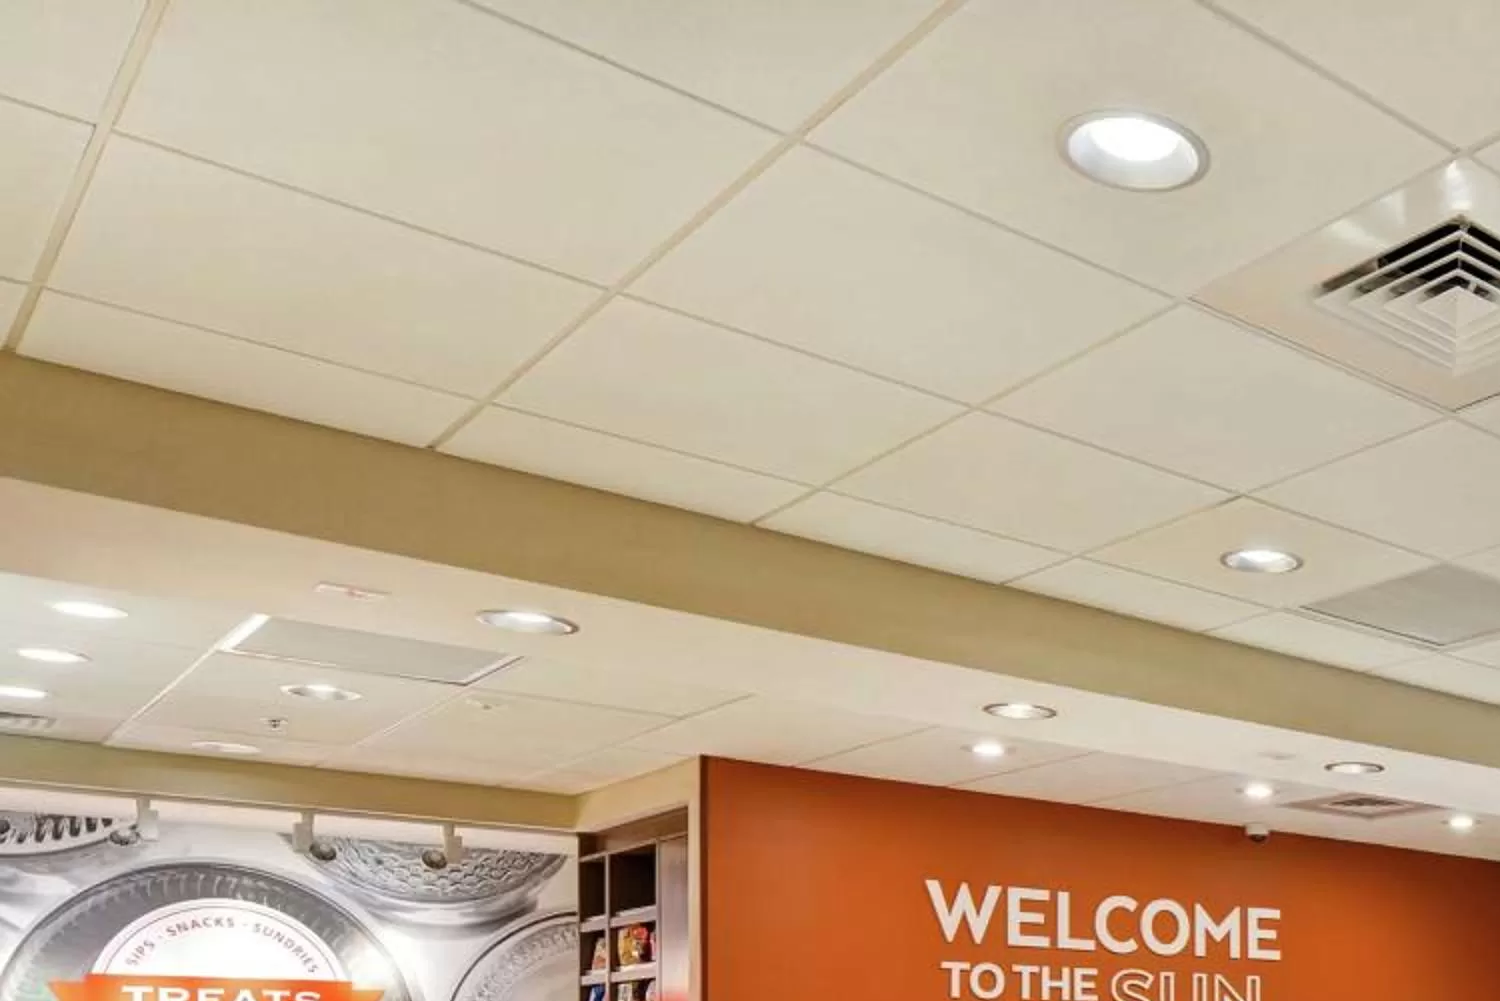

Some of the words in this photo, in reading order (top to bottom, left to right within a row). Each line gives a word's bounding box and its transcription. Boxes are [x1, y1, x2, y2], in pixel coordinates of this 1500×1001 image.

[124, 939, 156, 967] SIPS
[165, 916, 235, 938] SNACKS
[252, 922, 319, 974] SUNDRIES
[925, 879, 1282, 961] WELCOME
[940, 961, 1005, 1000] TO
